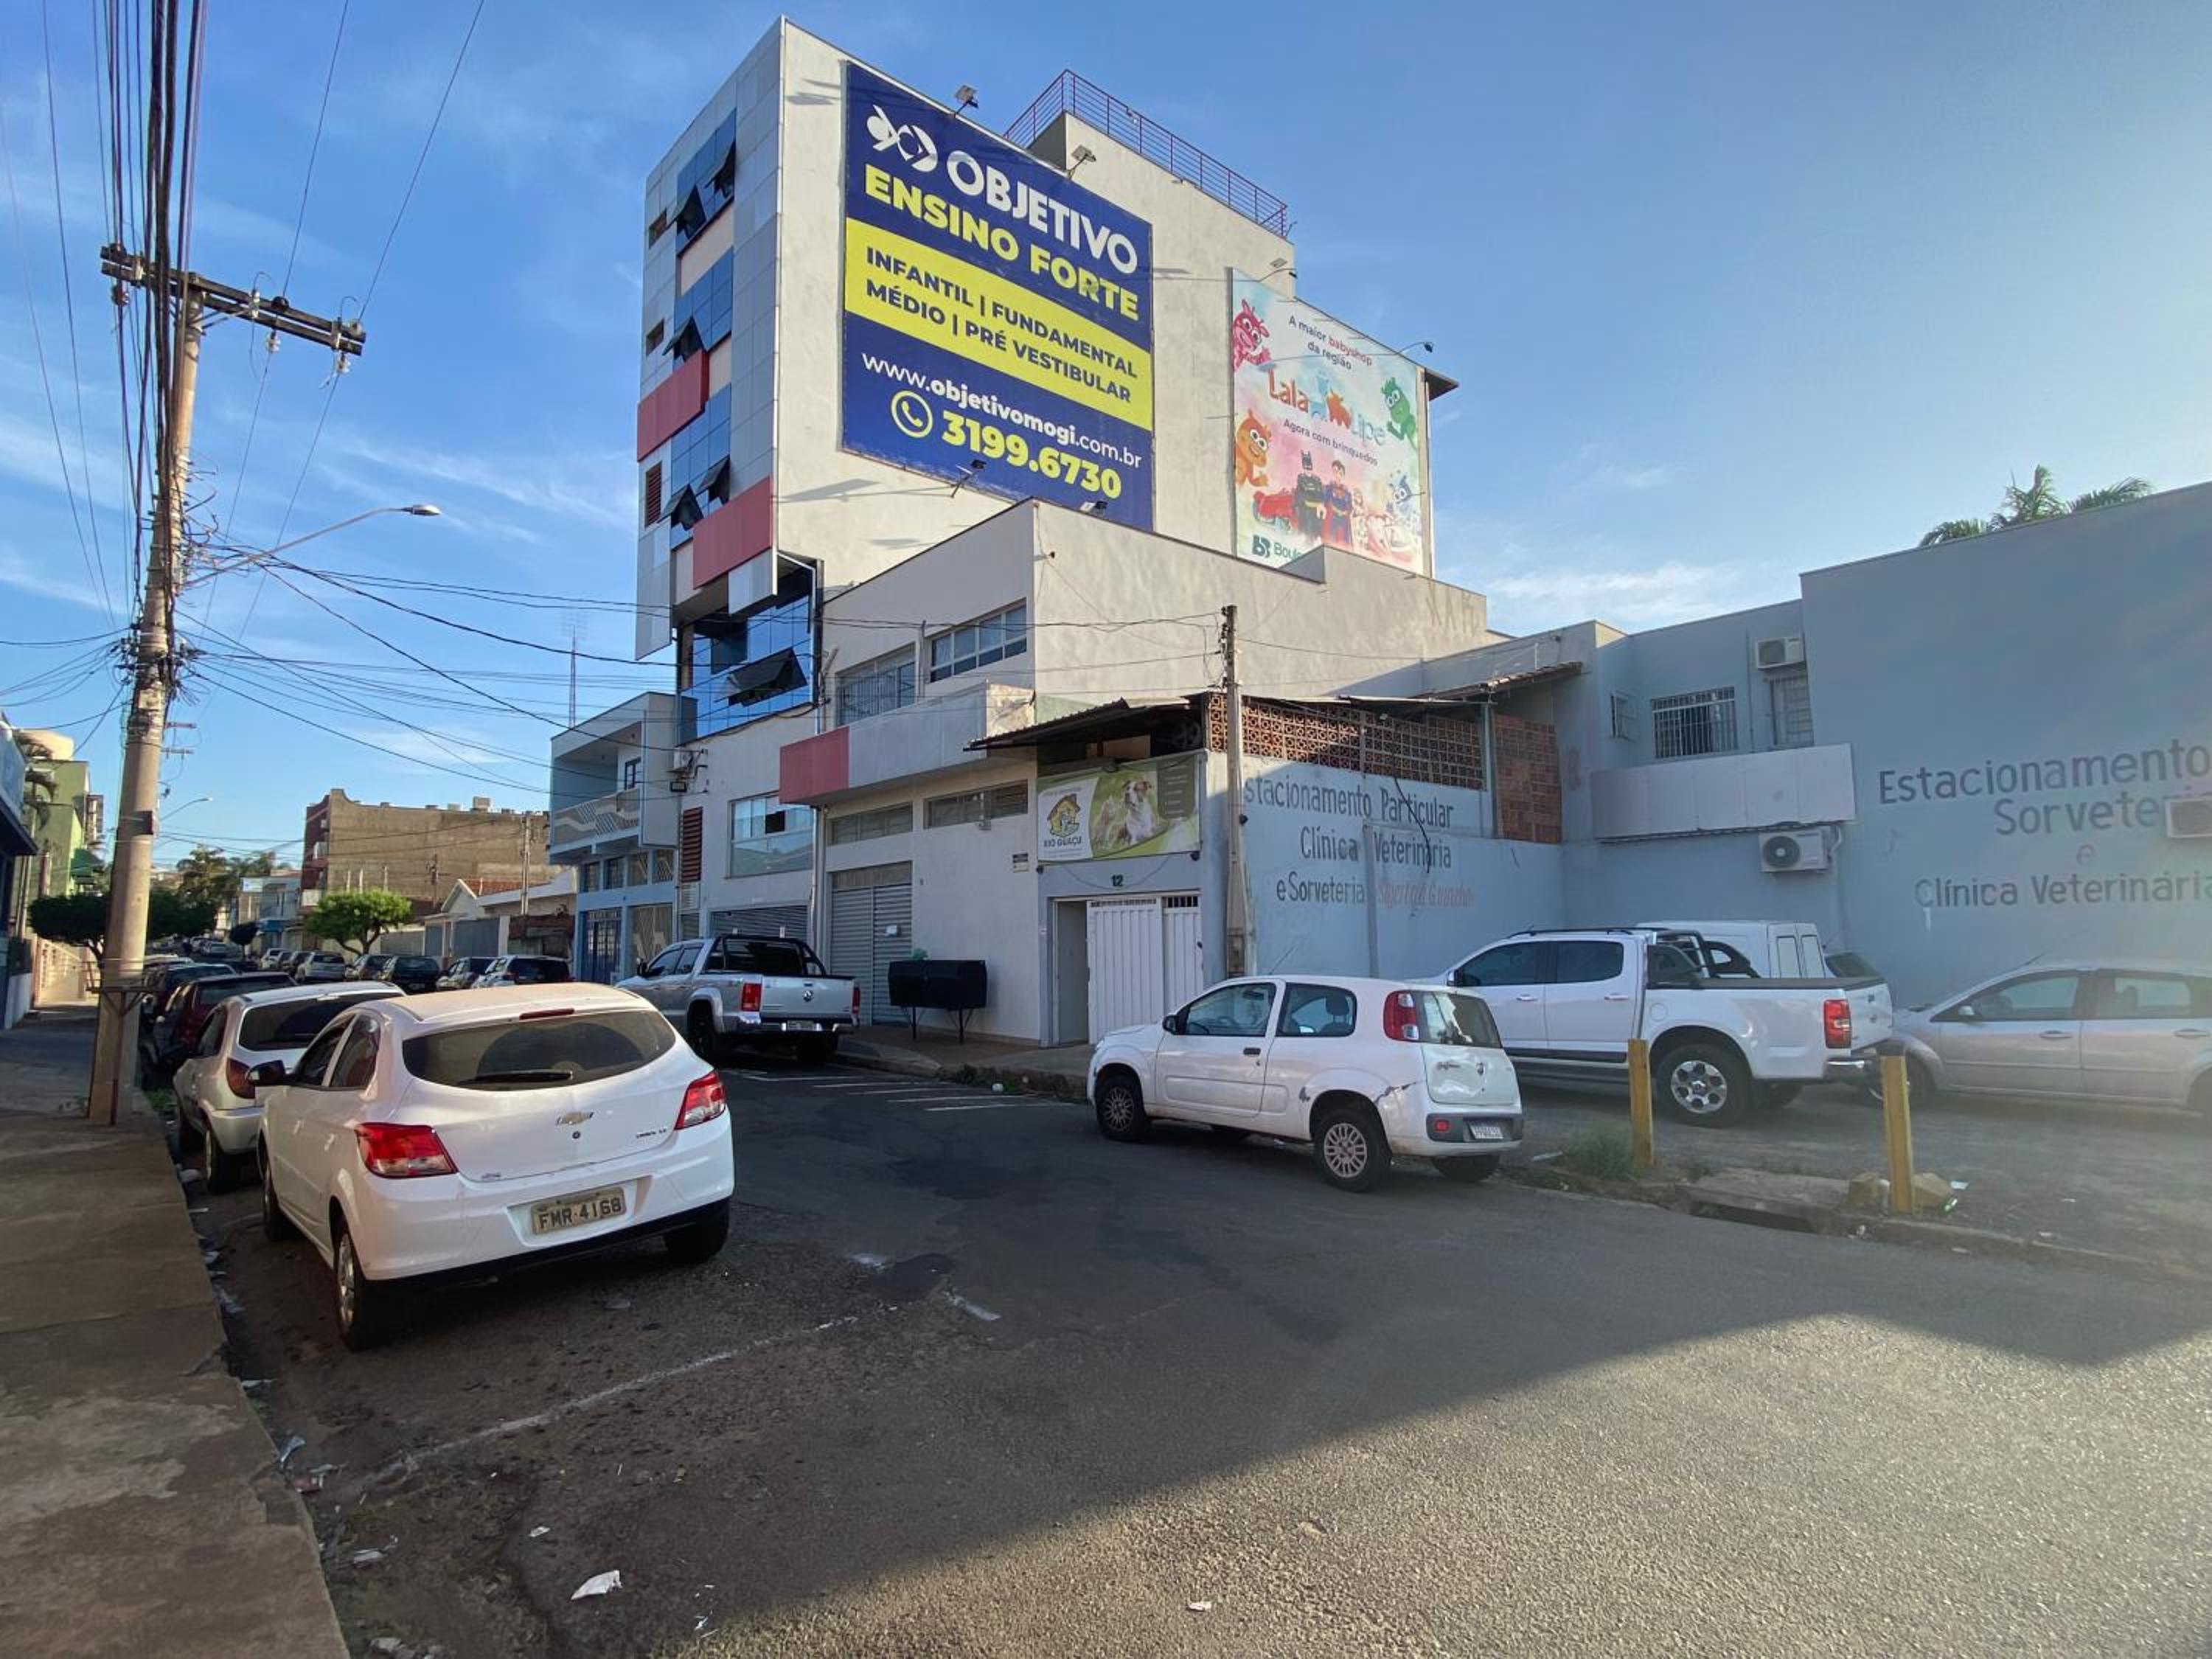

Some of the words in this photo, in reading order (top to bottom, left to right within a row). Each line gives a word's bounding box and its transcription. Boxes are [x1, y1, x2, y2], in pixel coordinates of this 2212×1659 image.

[946, 150, 1138, 274] OBJETIVO
[865, 164, 1020, 261] ENSINO
[1030, 243, 1139, 321] FORTE
[866, 247, 974, 308] INFANTIL
[992, 304, 1138, 378] FUNDAMENTAL
[866, 279, 945, 326] MÉDIO
[965, 320, 1006, 351] PRÉ
[1013, 340, 1132, 403] VESTIBULAR
[1289, 315, 1296, 327] A
[1298, 321, 1326, 341] maior
[1328, 335, 1372, 366] babyshop
[1307, 341, 1321, 354] da
[1322, 349, 1352, 369] região
[861, 353, 1142, 469] www.objetivomogi.com.br
[1268, 369, 1309, 413] Lala
[942, 410, 1121, 499] 3199.6730
[1283, 418, 1310, 437] Agora
[1312, 431, 1331, 446] com
[1332, 439, 1378, 466] brinquedos
[1879, 738, 2211, 805] Estacionamento
[1244, 774, 1371, 818] stacionamento
[1380, 786, 1455, 828] Particular
[1300, 824, 1359, 862] Clínica
[1374, 830, 1452, 869] Veterinária
[2076, 844, 2096, 866] e
[1110, 874, 1124, 887] 12
[1914, 875, 2018, 908] Clínica
